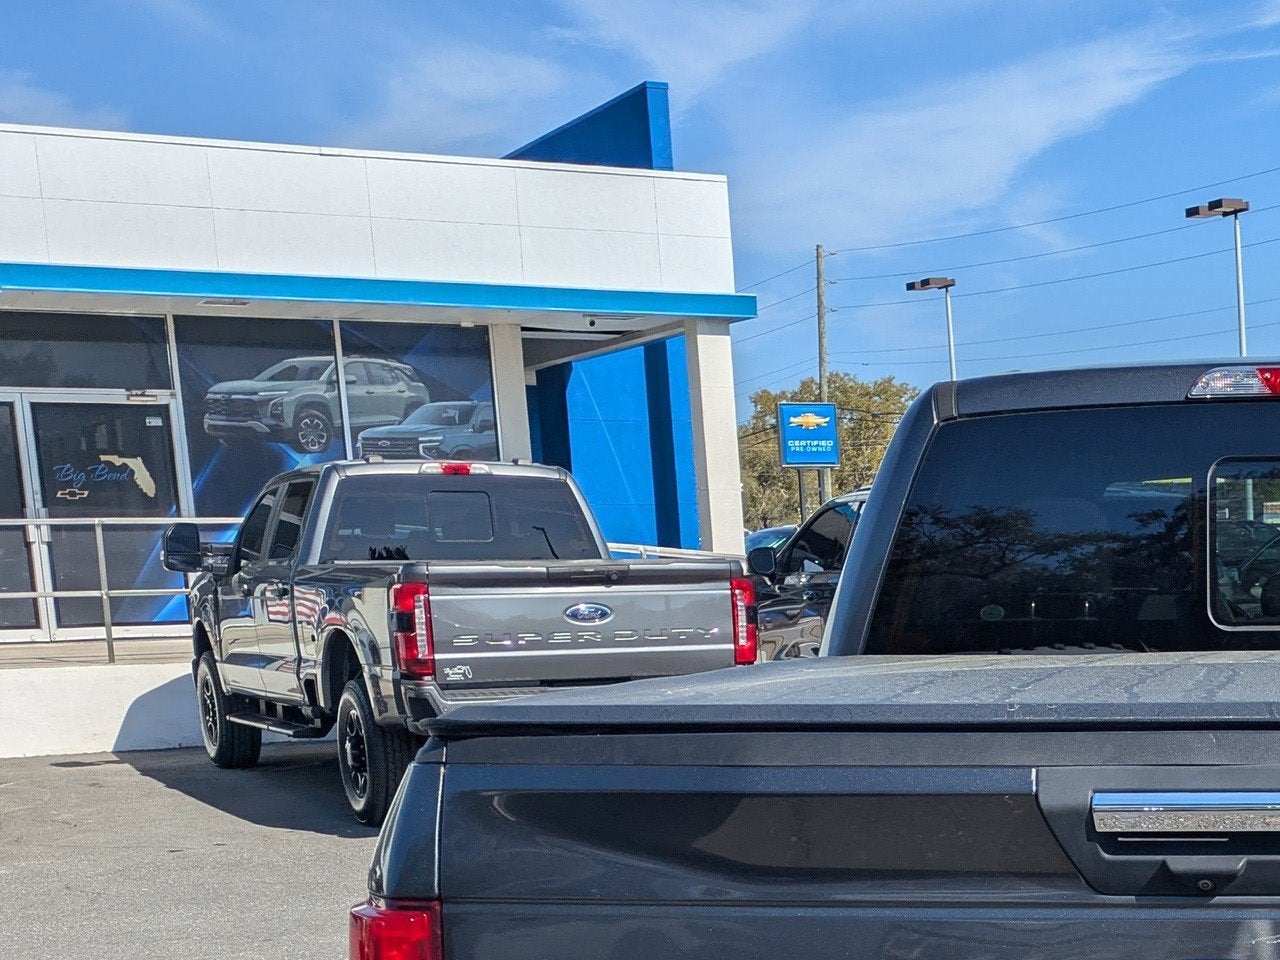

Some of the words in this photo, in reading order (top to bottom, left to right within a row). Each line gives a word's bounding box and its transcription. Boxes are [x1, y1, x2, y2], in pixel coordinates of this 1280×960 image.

[53, 463, 87, 488] Big
[87, 463, 132, 481] Bend
[453, 631, 602, 646] SUPER
[614, 627, 719, 641] DUTY
